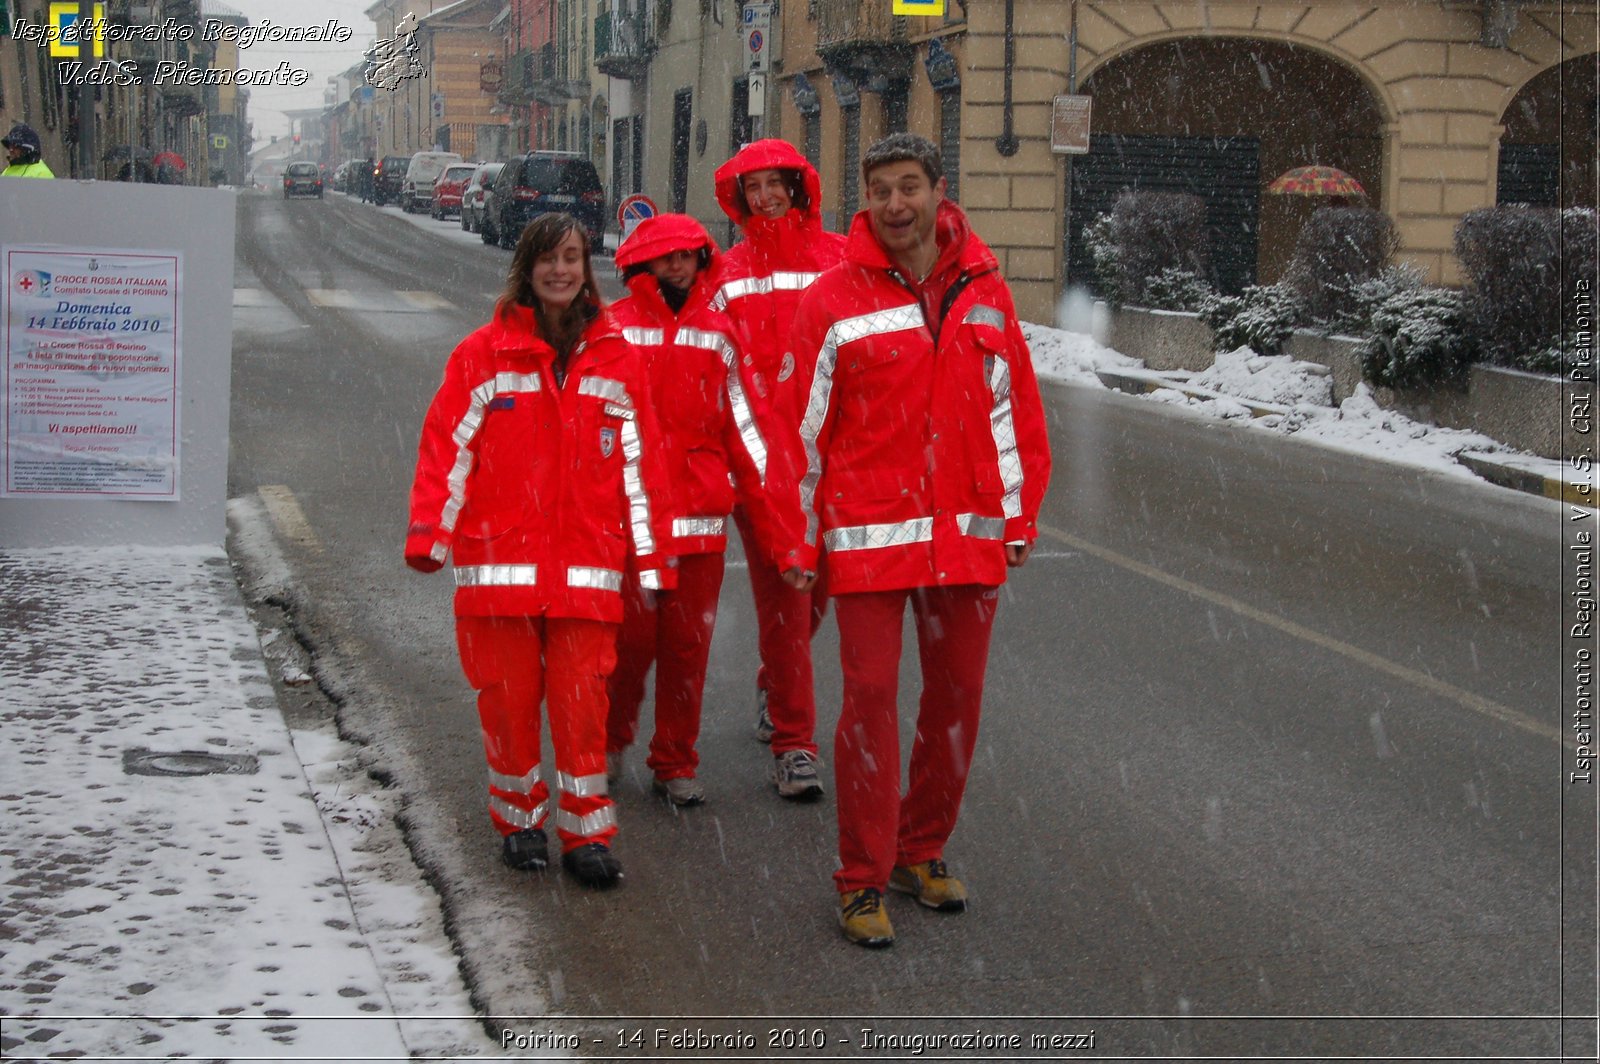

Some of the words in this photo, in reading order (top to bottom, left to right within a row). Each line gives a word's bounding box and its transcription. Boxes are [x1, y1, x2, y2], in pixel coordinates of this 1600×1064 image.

[55, 276, 88, 284] CROCE
[90, 276, 123, 285] ROSSA
[125, 278, 168, 286] ITALIANA
[54, 286, 92, 294] Comitato
[94, 287, 120, 296] Locale
[132, 288, 168, 296] POIRINO
[56, 301, 132, 316] Domenica
[27, 316, 46, 329] 14
[52, 316, 116, 330] Febbraio
[121, 319, 160, 332] 2010
[38, 341, 48, 350] La
[50, 342, 76, 350] Croce
[78, 342, 104, 350] Rossa
[106, 342, 115, 350] di
[116, 343, 147, 352] Poirino
[66, 352, 97, 360] invitare
[108, 354, 160, 362] popolazione
[103, 364, 126, 372] nuovi
[128, 365, 170, 374] automezzi
[48, 424, 60, 432] Vi
[62, 424, 138, 436] aspettiamo!!!
